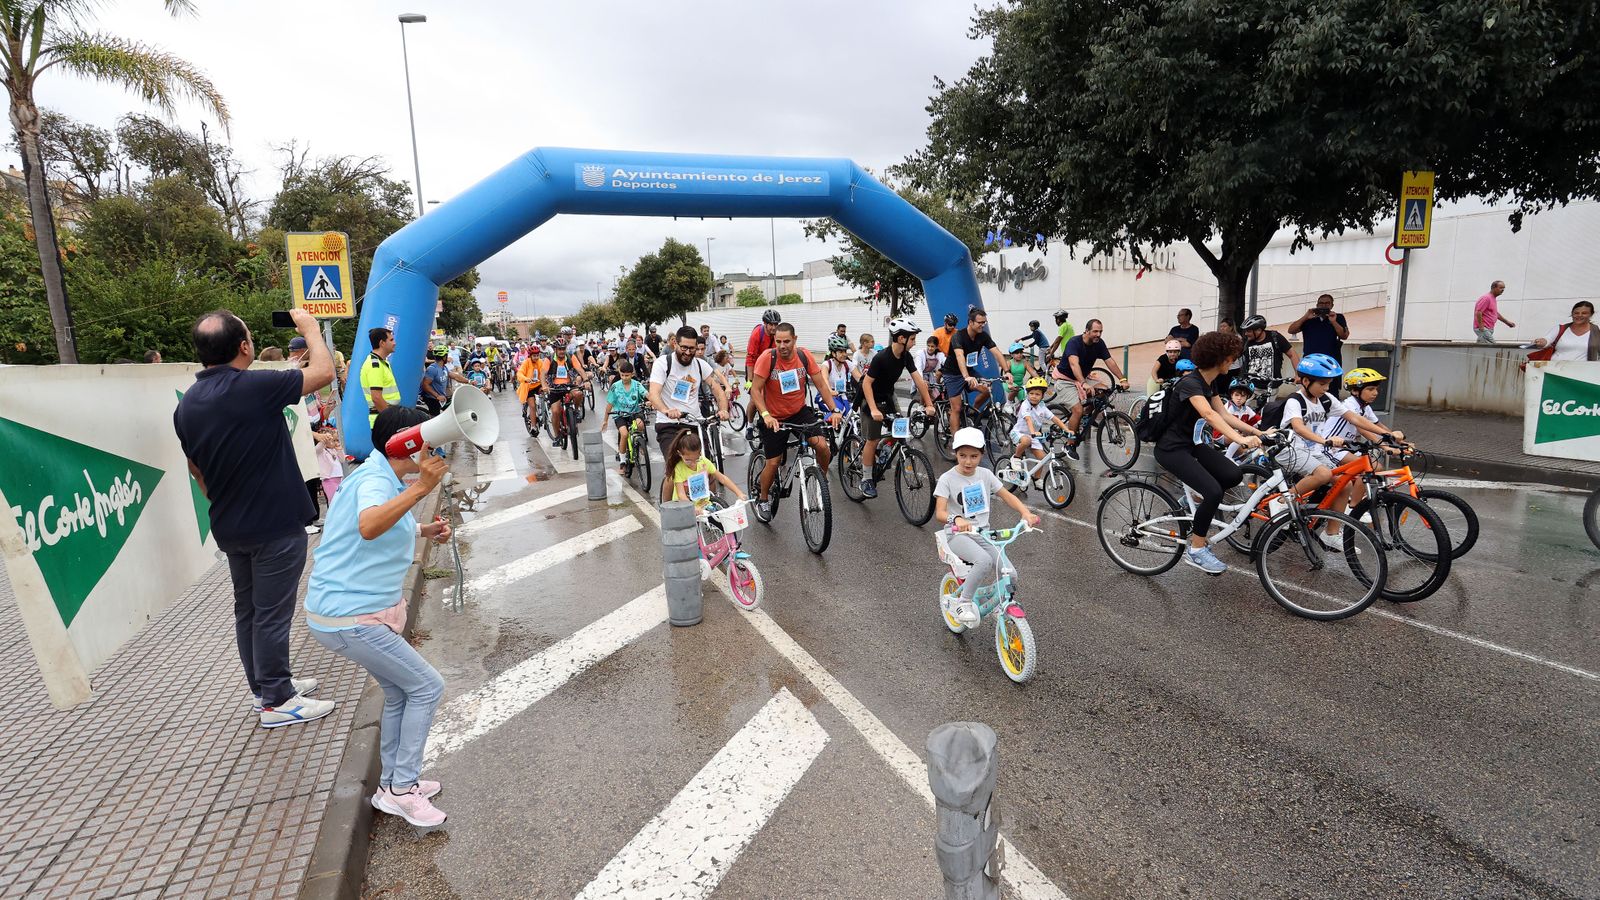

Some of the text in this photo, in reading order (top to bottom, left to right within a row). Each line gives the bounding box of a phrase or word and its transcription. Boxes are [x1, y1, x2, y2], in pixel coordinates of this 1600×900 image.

[611, 168, 822, 185] Ayuntamiento de Jerez
[611, 180, 677, 190] Deportes
[1541, 399, 1561, 415] El
[38, 492, 95, 547] Corte
[82, 467, 143, 540] Inglés
